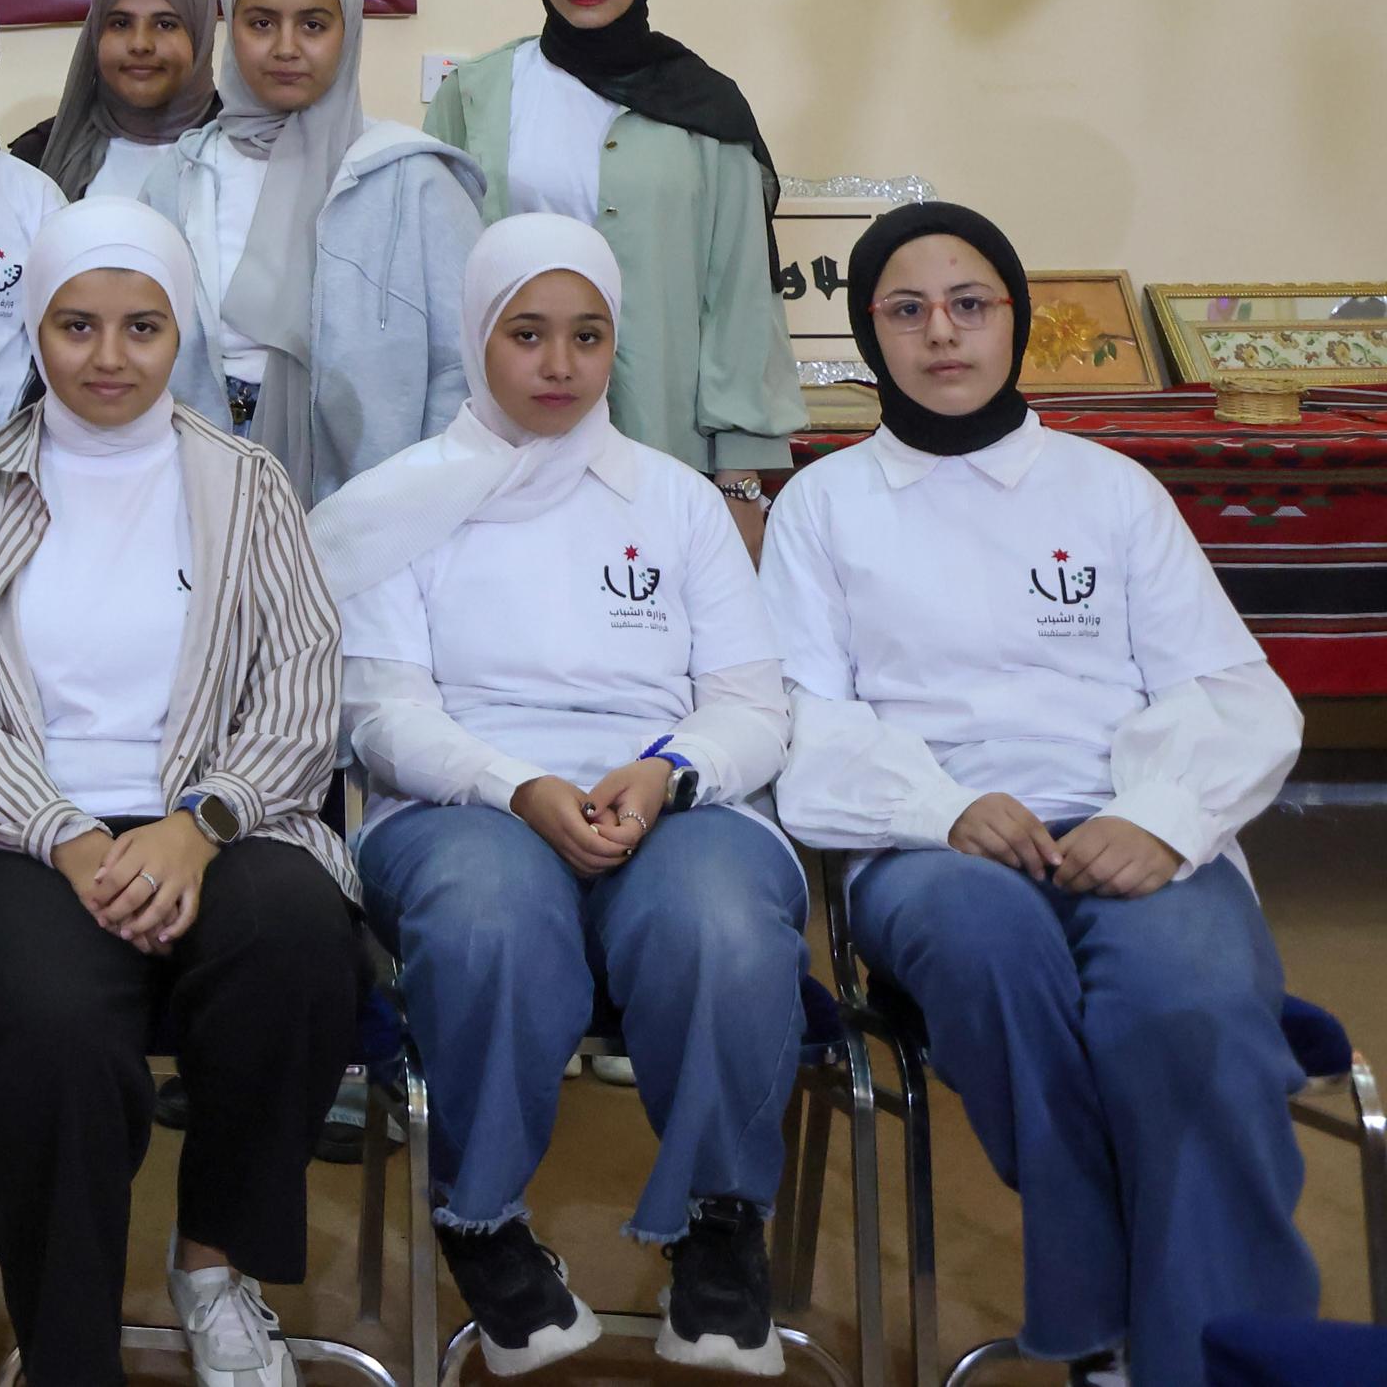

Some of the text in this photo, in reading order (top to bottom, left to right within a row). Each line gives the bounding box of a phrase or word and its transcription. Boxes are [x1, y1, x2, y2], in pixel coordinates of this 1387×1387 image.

[609, 606, 667, 622] وزارة الشباب
[1036, 612, 1101, 626] وزارة الشباب
